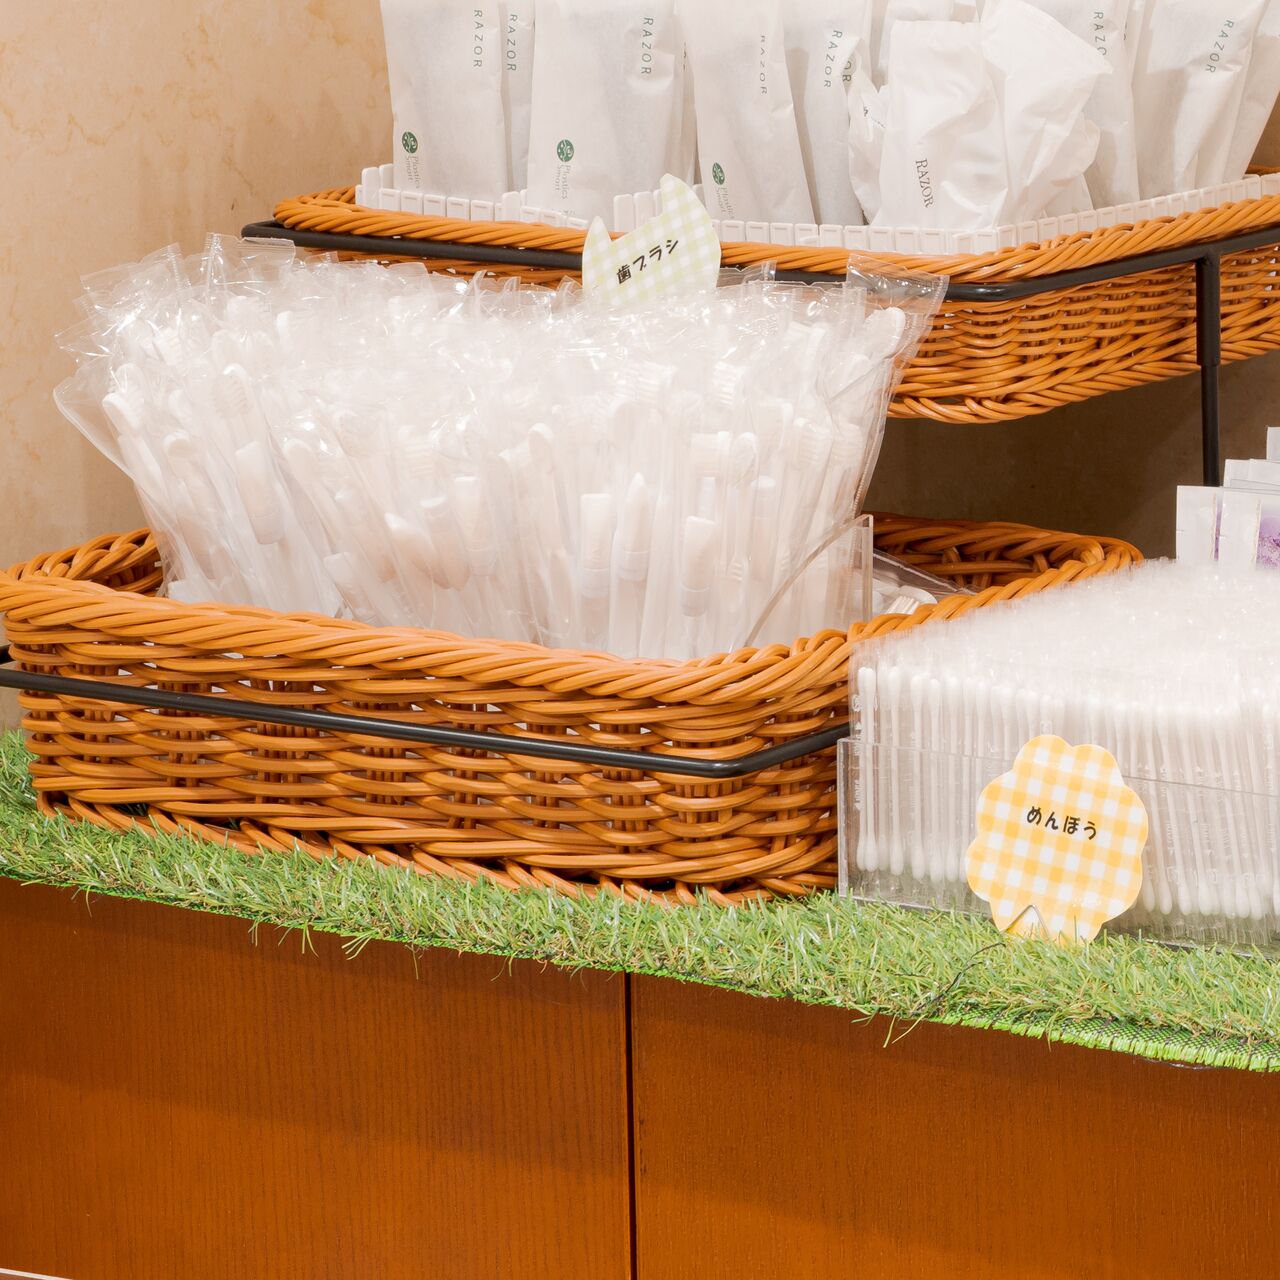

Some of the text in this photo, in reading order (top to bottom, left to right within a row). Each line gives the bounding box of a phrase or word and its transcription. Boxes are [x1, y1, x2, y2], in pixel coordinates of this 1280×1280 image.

[473, 8, 484, 69] RAZOR
[505, 13, 518, 72] RAZOR
[640, 16, 655, 75] RAZOR
[822, 28, 843, 89] RAZOR
[1093, 11, 1108, 57] RAZO
[1205, 18, 1235, 74] RAZOR
[914, 157, 936, 209] RAZOR
[616, 239, 679, 285] 歯ブラシ
[1026, 805, 1098, 840] めんぼう
